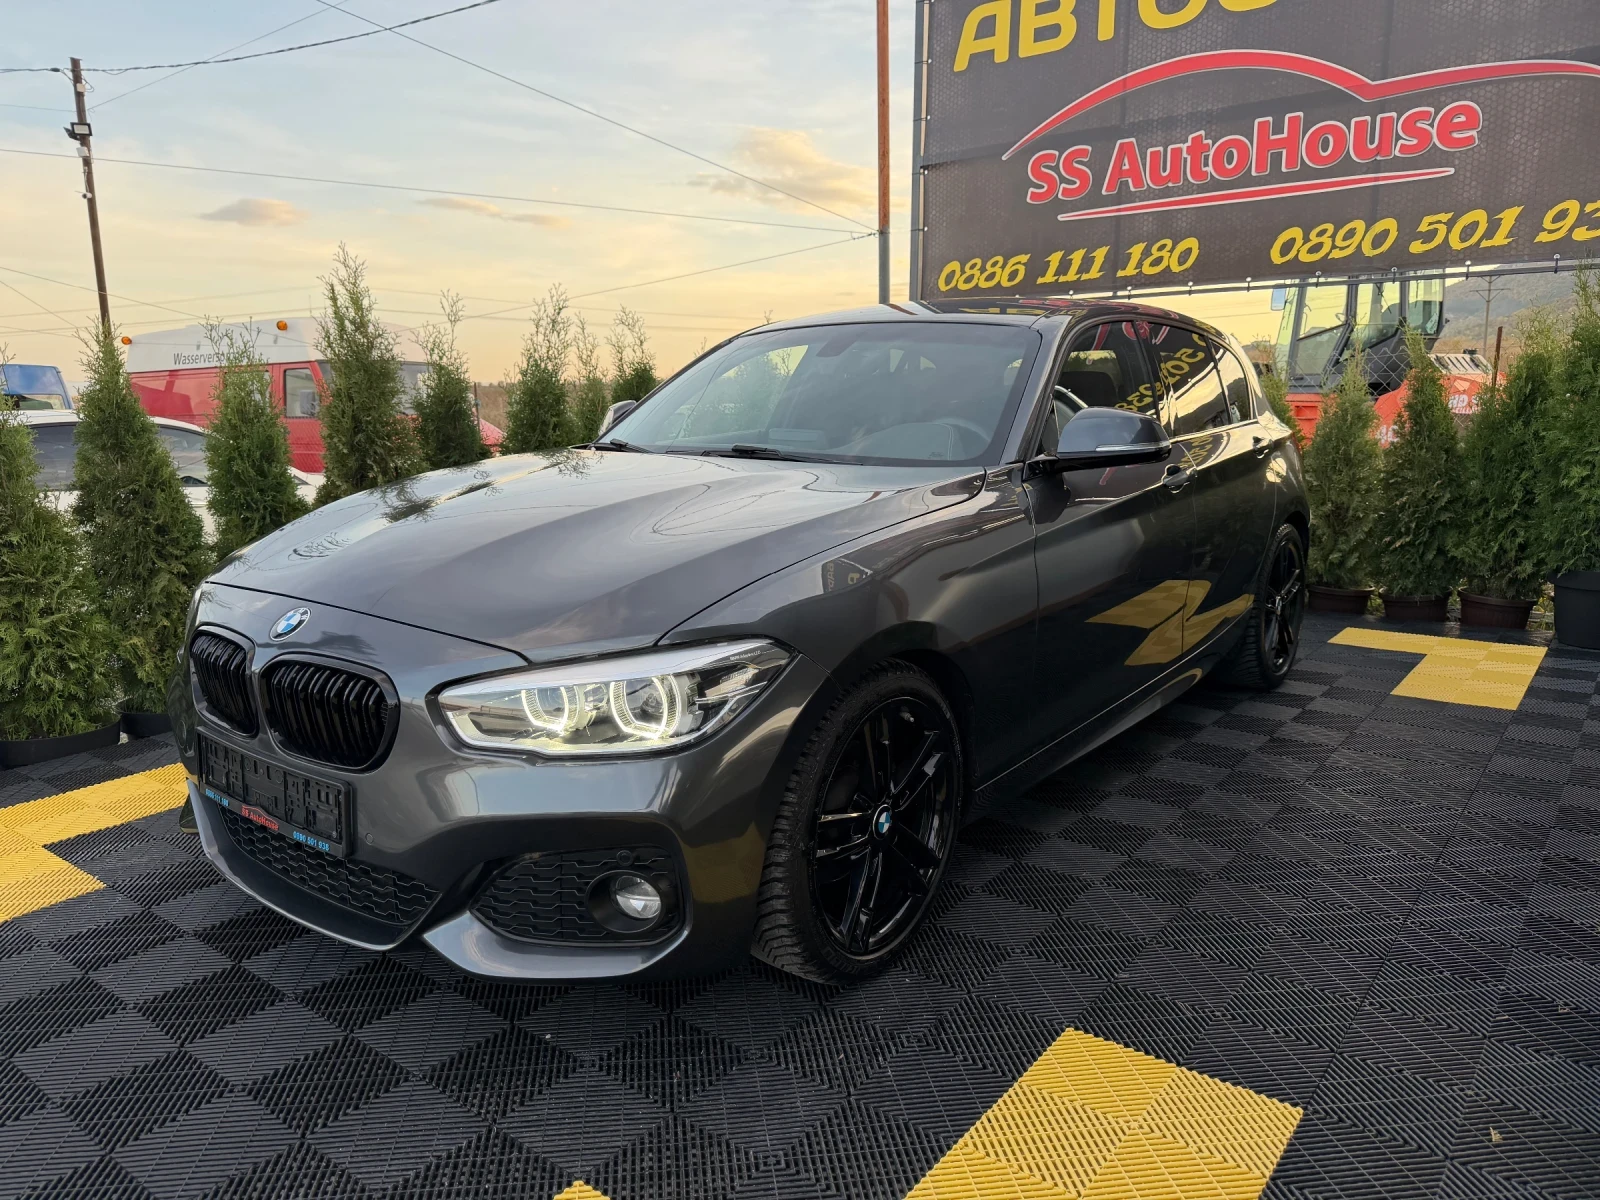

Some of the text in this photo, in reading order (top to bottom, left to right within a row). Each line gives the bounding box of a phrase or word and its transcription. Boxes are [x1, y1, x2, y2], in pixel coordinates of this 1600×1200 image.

[1026, 101, 1482, 204] SS AutoHouse
[938, 237, 1199, 292] 0886 111 180
[1269, 218, 1398, 265] 0890
[1409, 205, 1525, 255] 501
